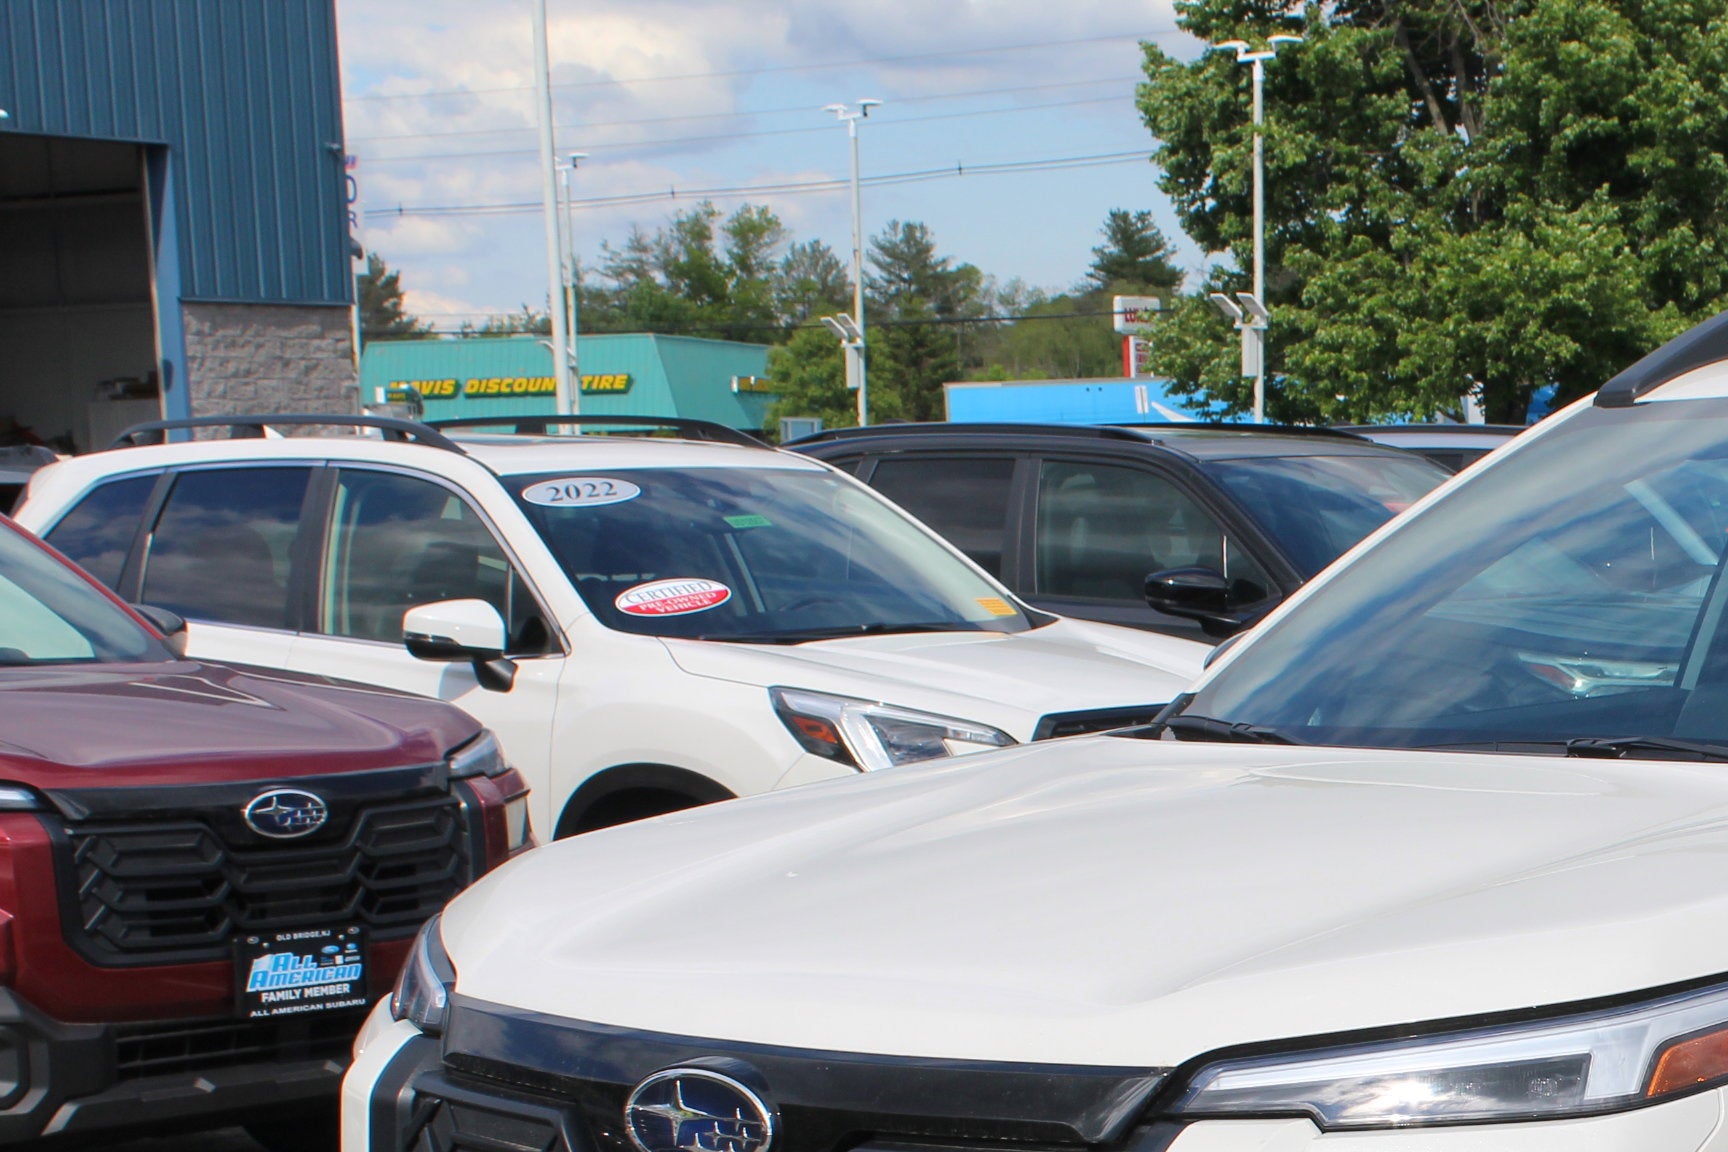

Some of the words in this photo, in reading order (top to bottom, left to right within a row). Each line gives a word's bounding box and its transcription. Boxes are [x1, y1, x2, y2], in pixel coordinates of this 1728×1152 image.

[390, 379, 456, 395] VIS
[464, 377, 556, 394] DISCOUN
[581, 374, 628, 390] TIRE
[547, 481, 617, 501] 2022
[625, 581, 712, 603] CERTIFIED
[639, 592, 717, 610] PRE-OWNED
[656, 600, 712, 613] VEHICLE
[261, 989, 301, 1003] FAMILY
[304, 983, 350, 998] MEMBER
[271, 1004, 324, 1015] AMERICAN
[325, 999, 366, 1009] SUBARU
